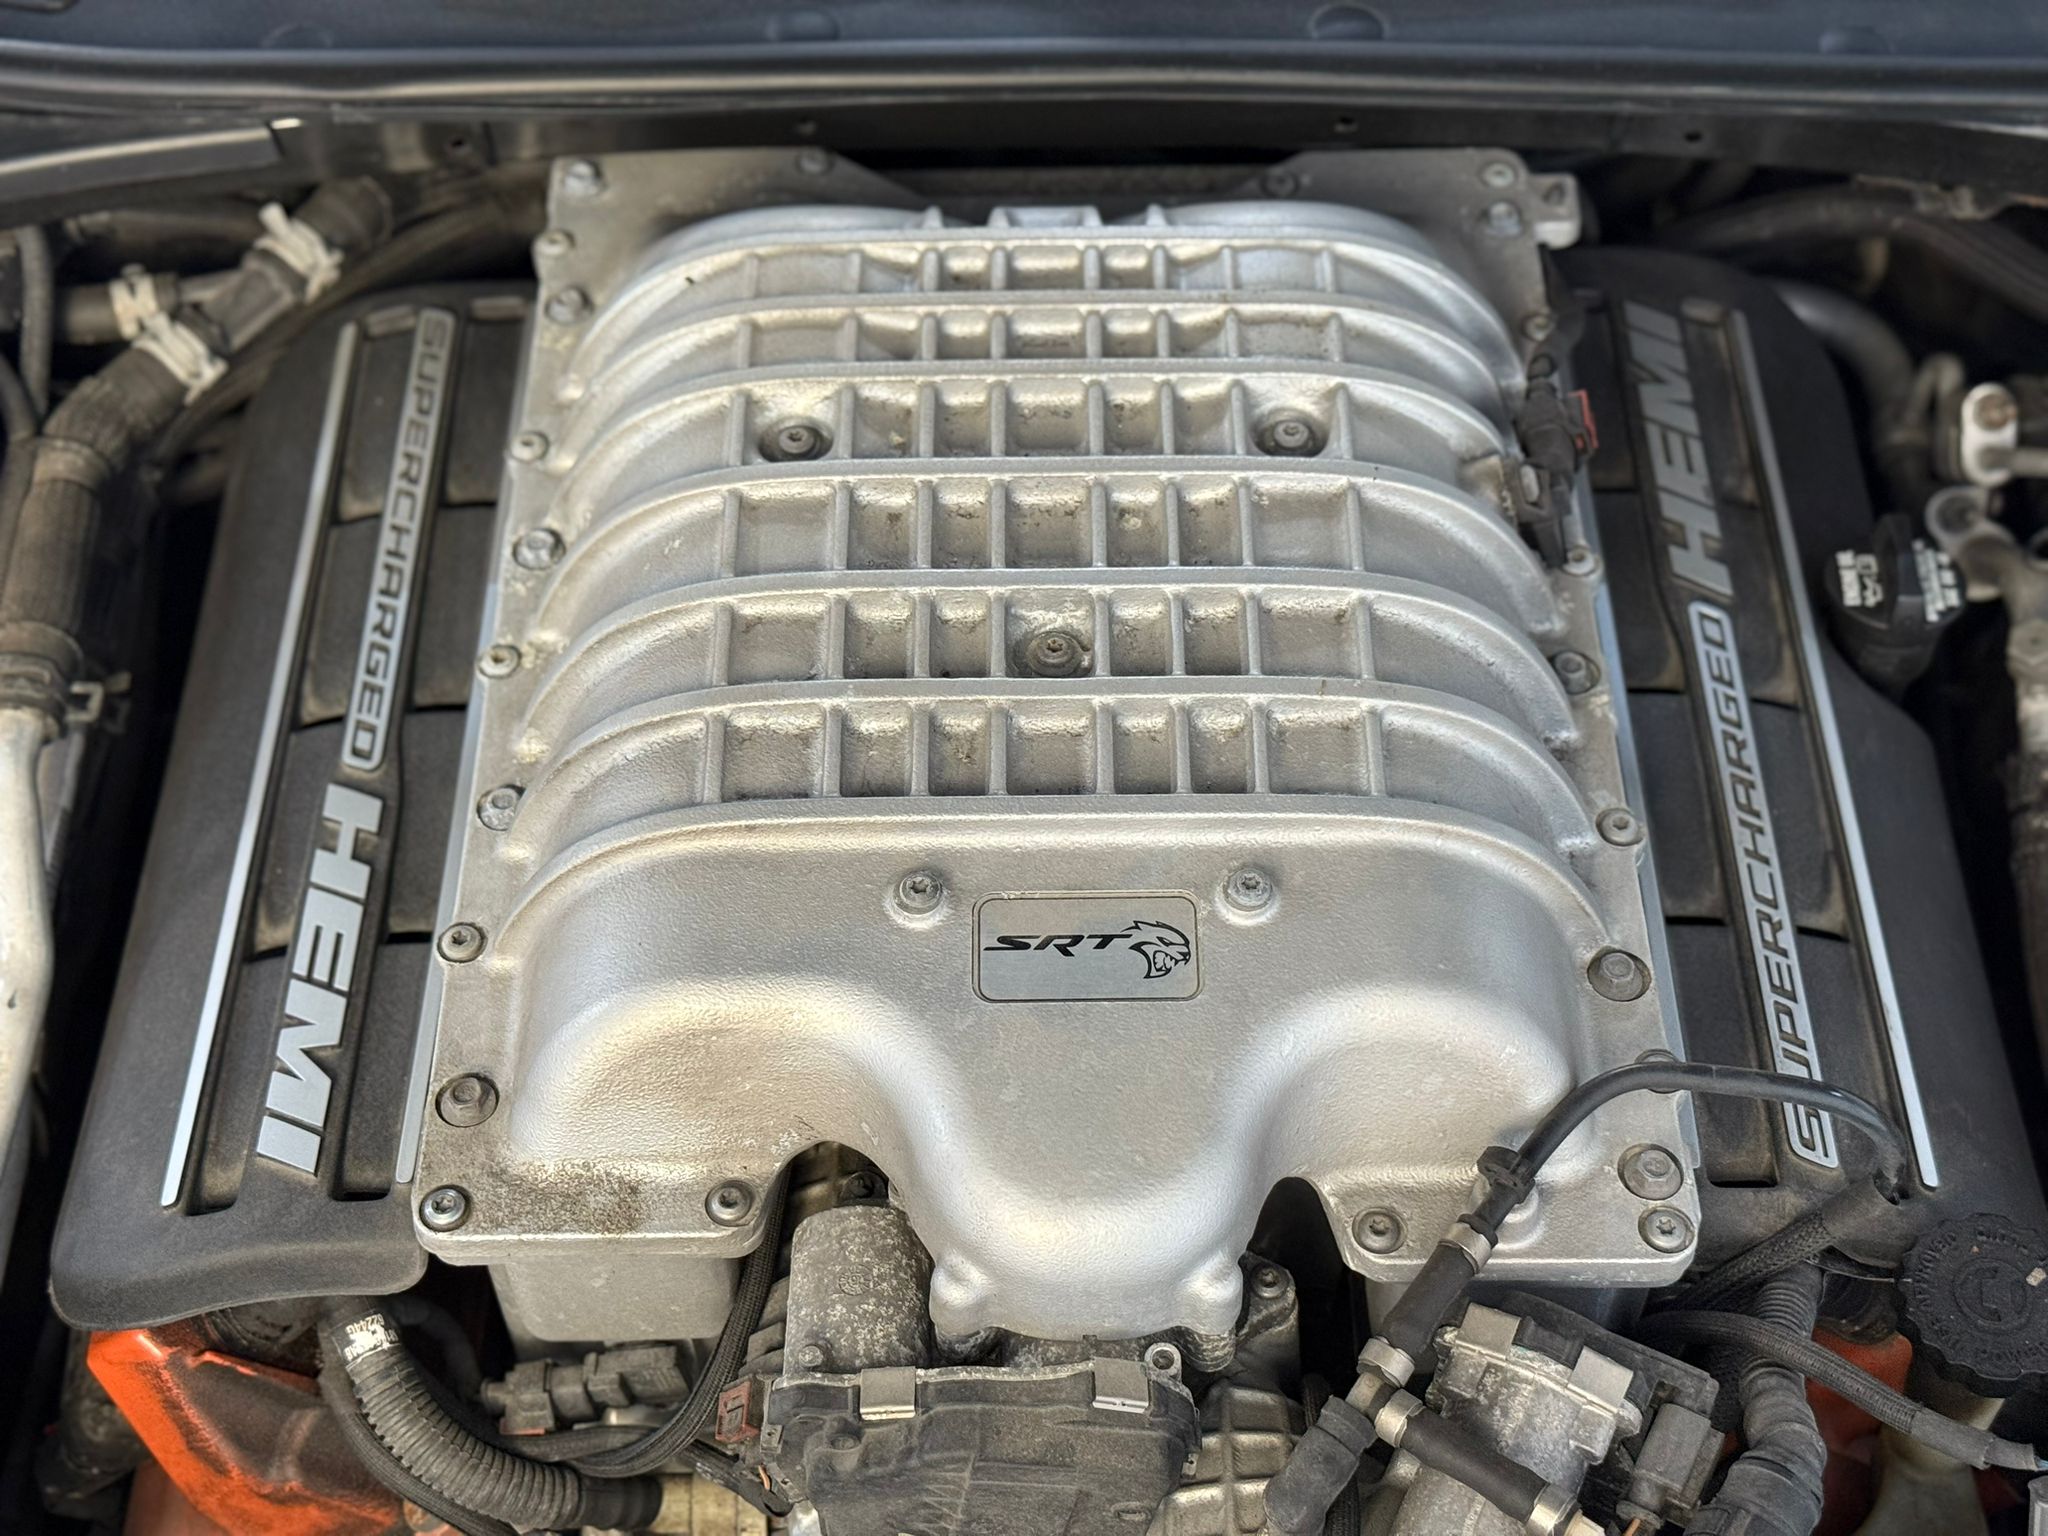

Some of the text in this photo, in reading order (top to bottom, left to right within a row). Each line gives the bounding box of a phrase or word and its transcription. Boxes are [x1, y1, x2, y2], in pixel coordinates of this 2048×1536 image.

[1624, 301, 1734, 598] HEMI
[257, 315, 451, 1175] SUPERCHARGED HEMI
[983, 934, 1133, 957] SRT
